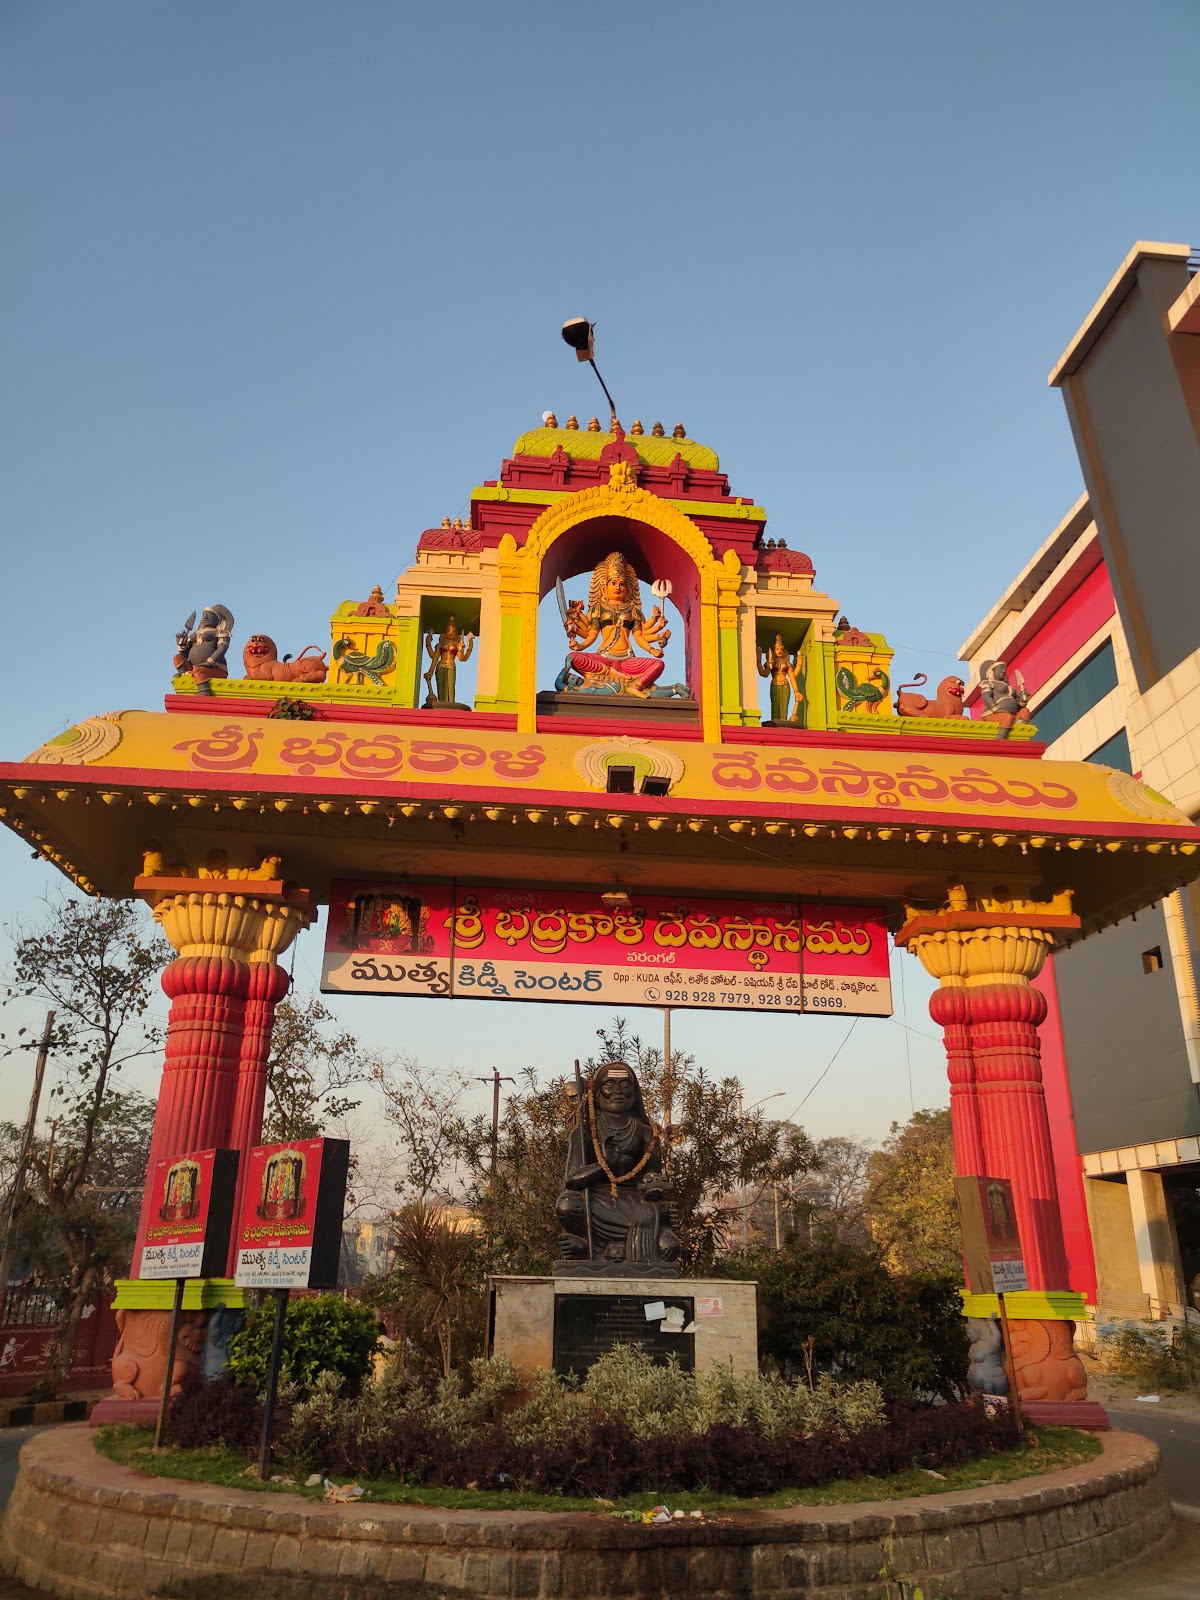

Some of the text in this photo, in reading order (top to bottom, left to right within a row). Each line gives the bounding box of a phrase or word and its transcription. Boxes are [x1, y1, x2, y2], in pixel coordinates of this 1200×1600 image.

[172, 725, 264, 771] శ్రీ
[443, 896, 485, 951] శ్రీ
[626, 952, 676, 964] వరంగల్
[350, 958, 603, 996] ముత్య కిడ్నీ సెంటర్
[613, 972, 629, 983] Opp
[636, 973, 660, 983] KUDA
[777, 976, 785, 991] శ్రీ
[665, 990, 847, 1009] 928 928 7979, 928 928 6969.
[241, 1250, 266, 1270] ముత్య
